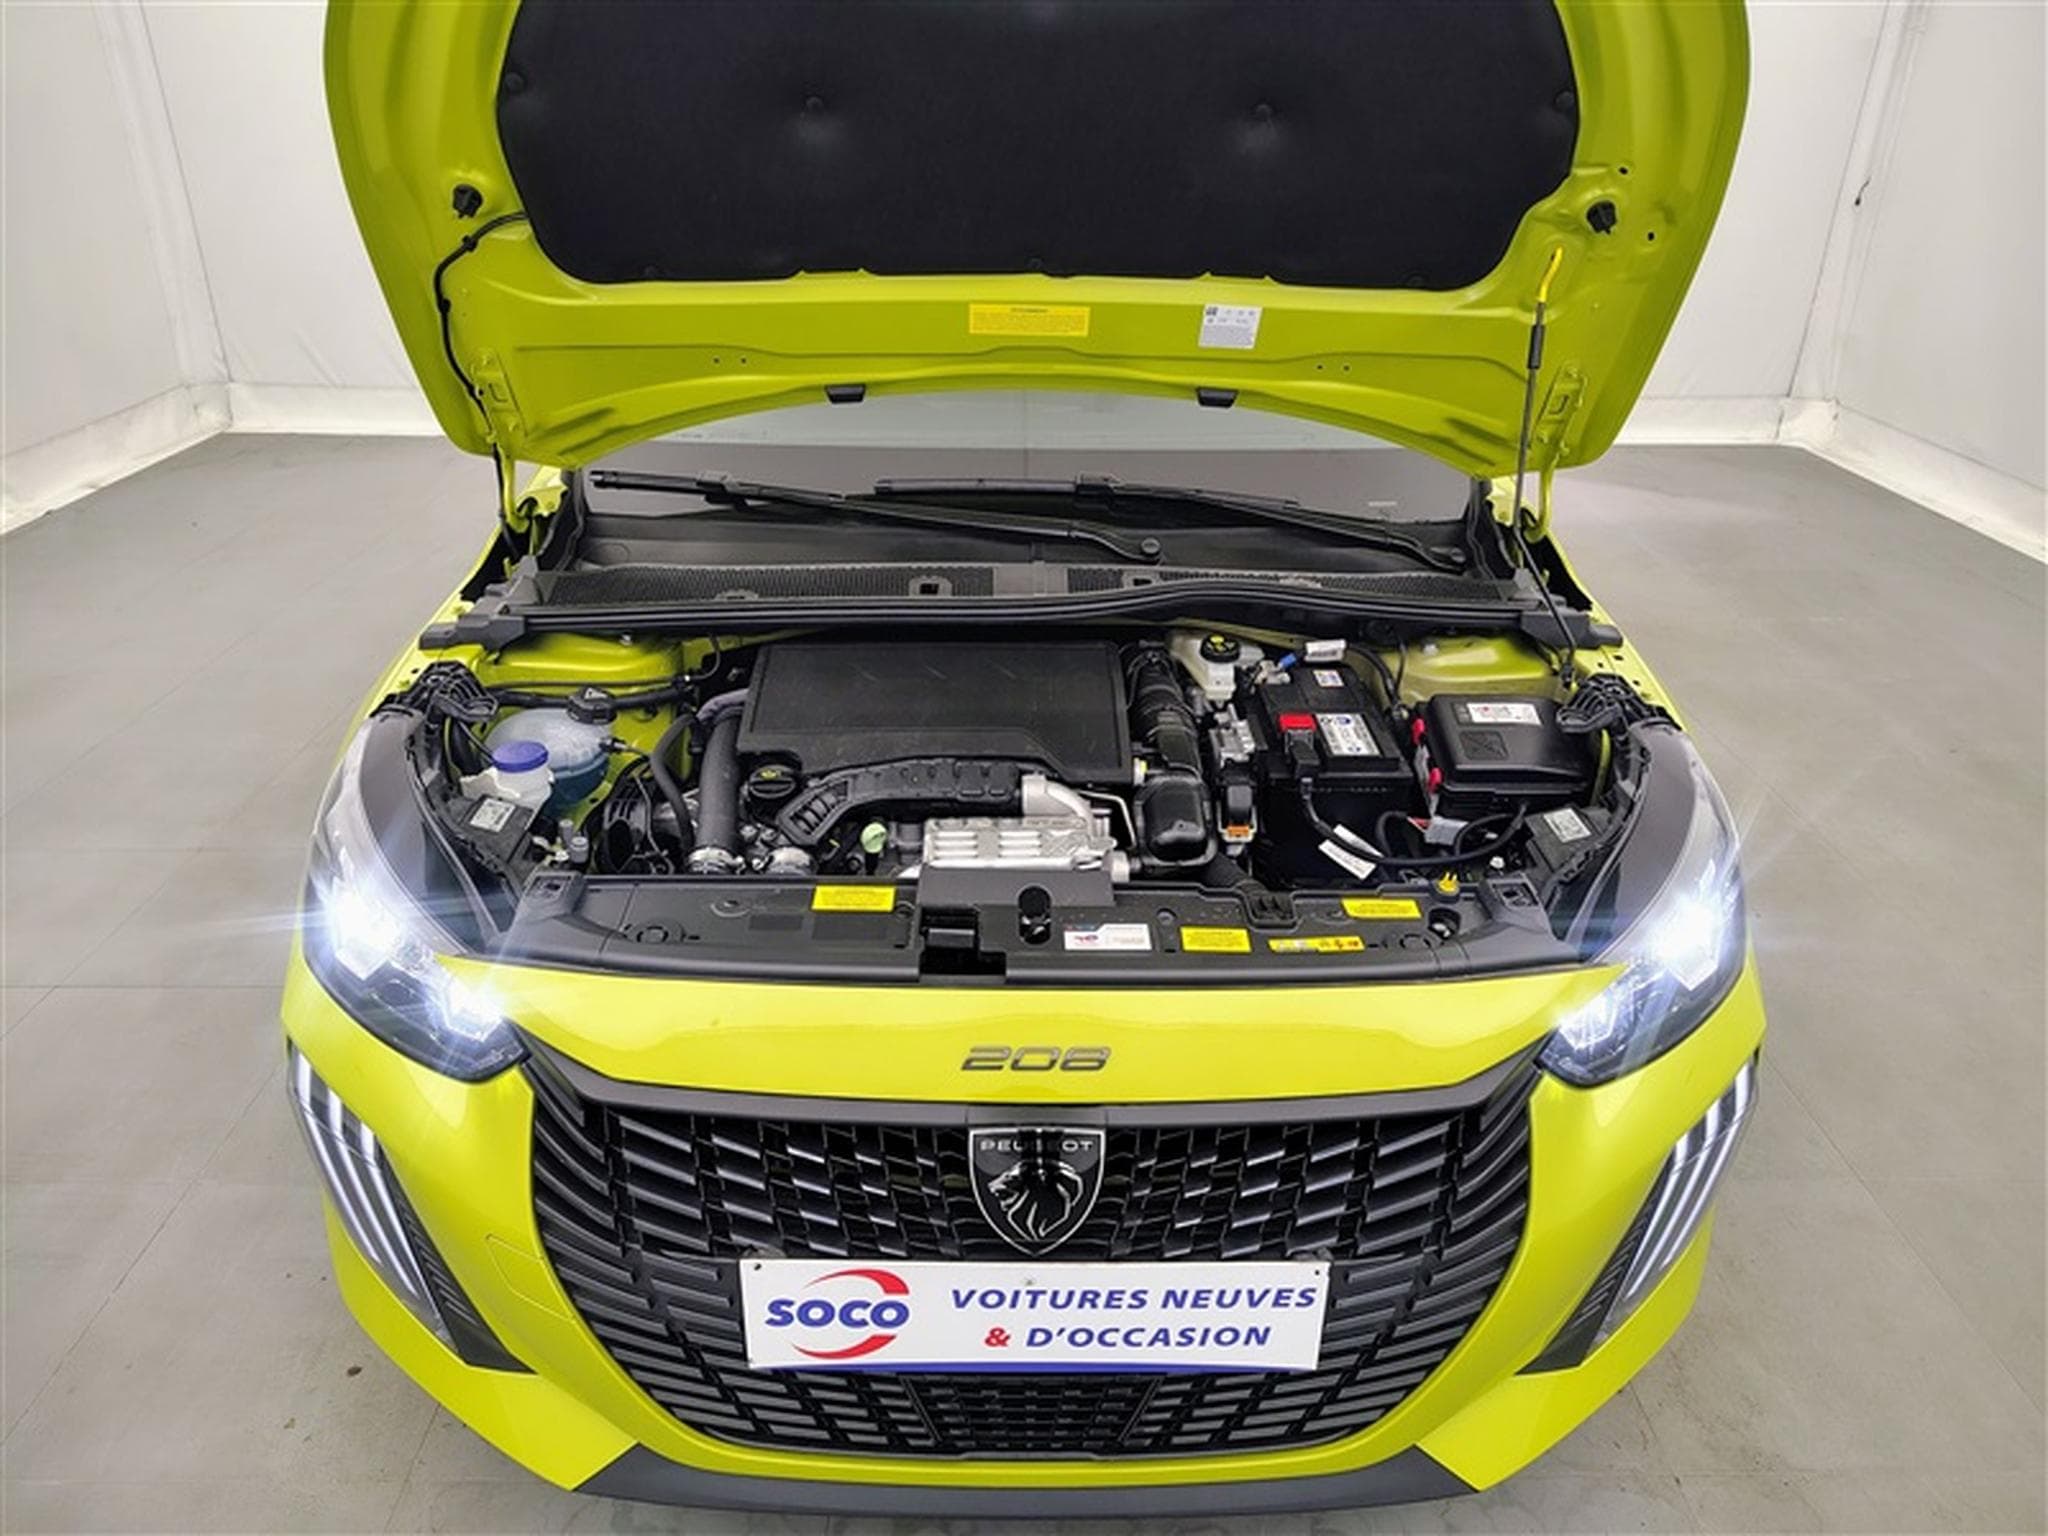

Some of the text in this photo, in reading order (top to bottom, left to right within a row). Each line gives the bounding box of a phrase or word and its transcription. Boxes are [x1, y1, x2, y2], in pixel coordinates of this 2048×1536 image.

[961, 1046, 1112, 1071] 208
[979, 1138, 1095, 1152] PEUOT
[951, 1287, 1318, 1310] VOITURES NEUVES
[765, 1299, 910, 1328] SOCO
[984, 1326, 1271, 1348] & D'OCCASION
